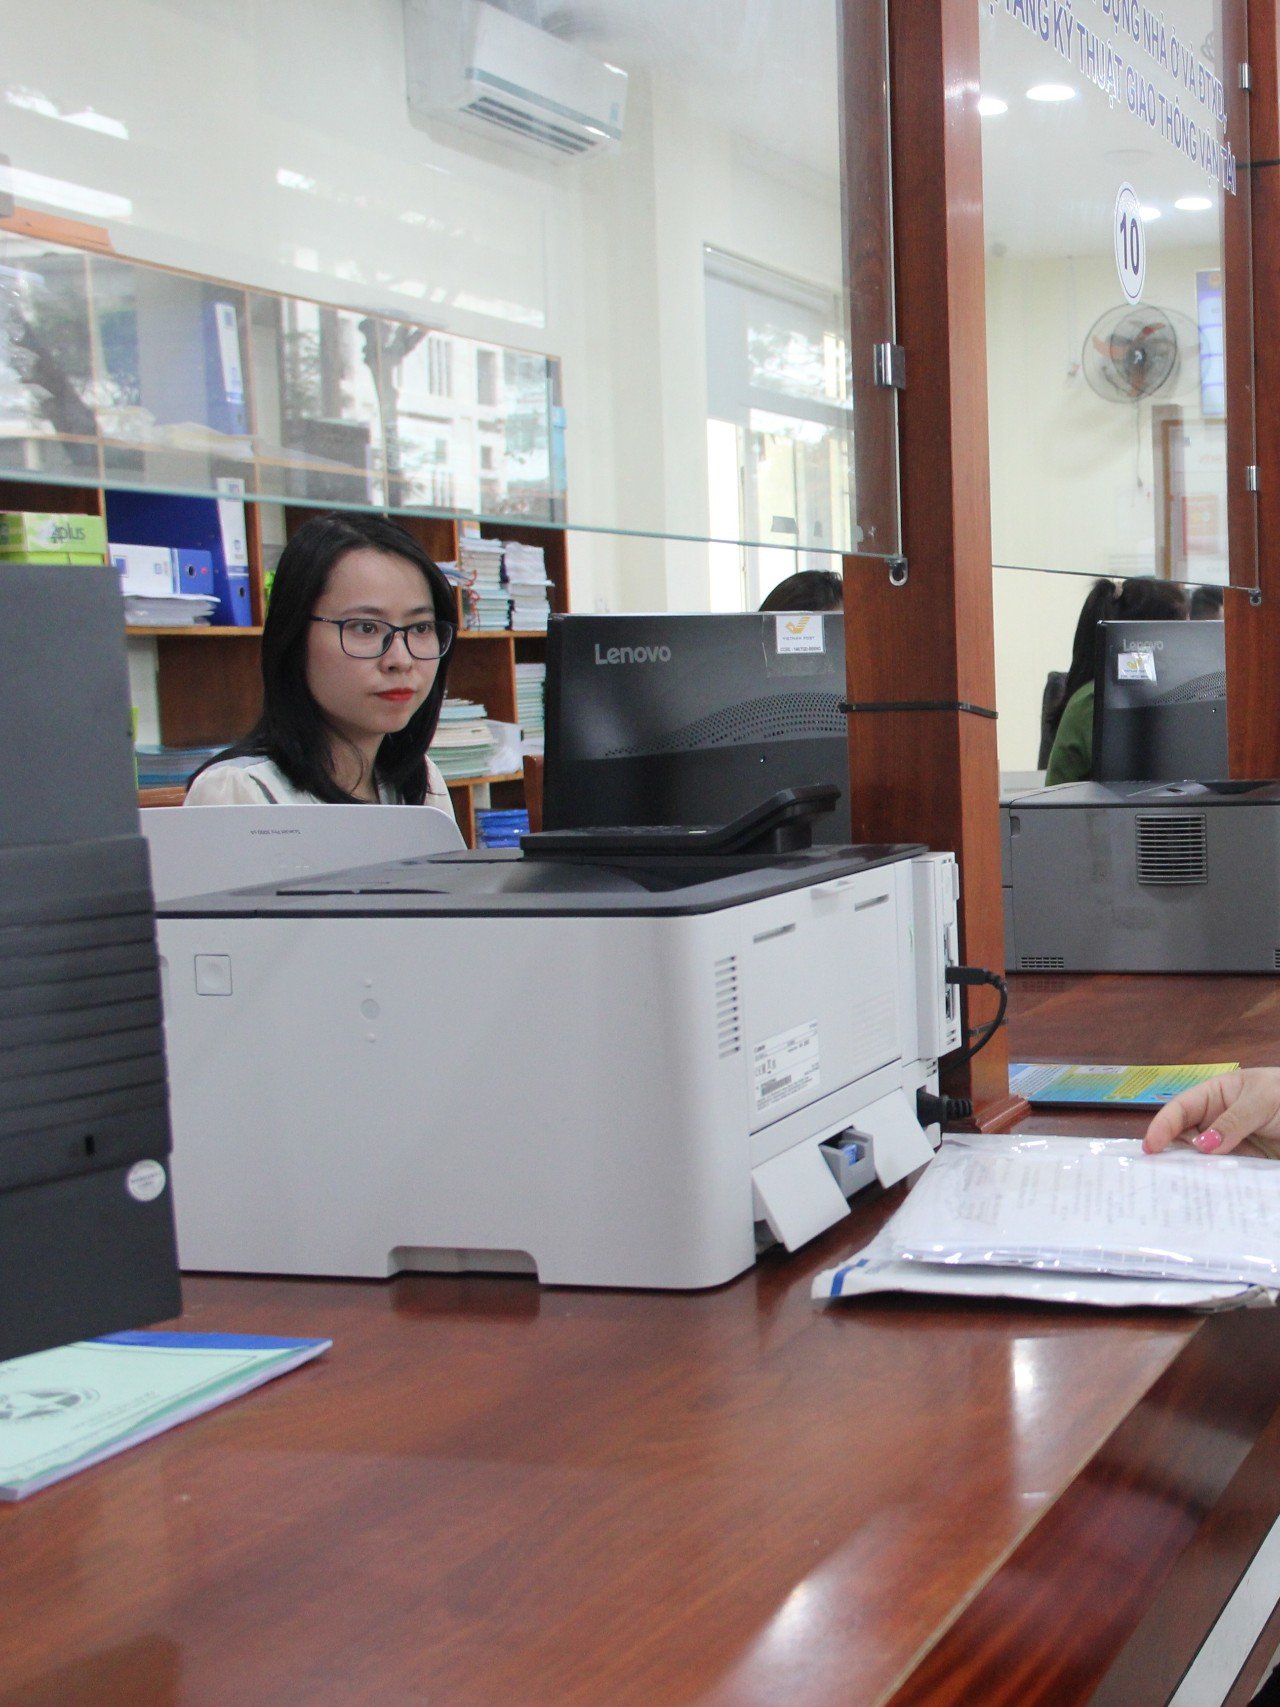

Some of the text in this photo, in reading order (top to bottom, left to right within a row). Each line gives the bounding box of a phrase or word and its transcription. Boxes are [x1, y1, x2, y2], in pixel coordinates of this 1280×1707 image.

[1076, 21, 1123, 109] THUẬT
[1125, 65, 1156, 127] GIAO
[1158, 94, 1198, 161] THÔNG
[1143, 7, 1168, 71] NHÀ
[1180, 42, 1198, 98] VÀ
[1119, 211, 1140, 276] 10
[594, 642, 672, 666] Lenovo
